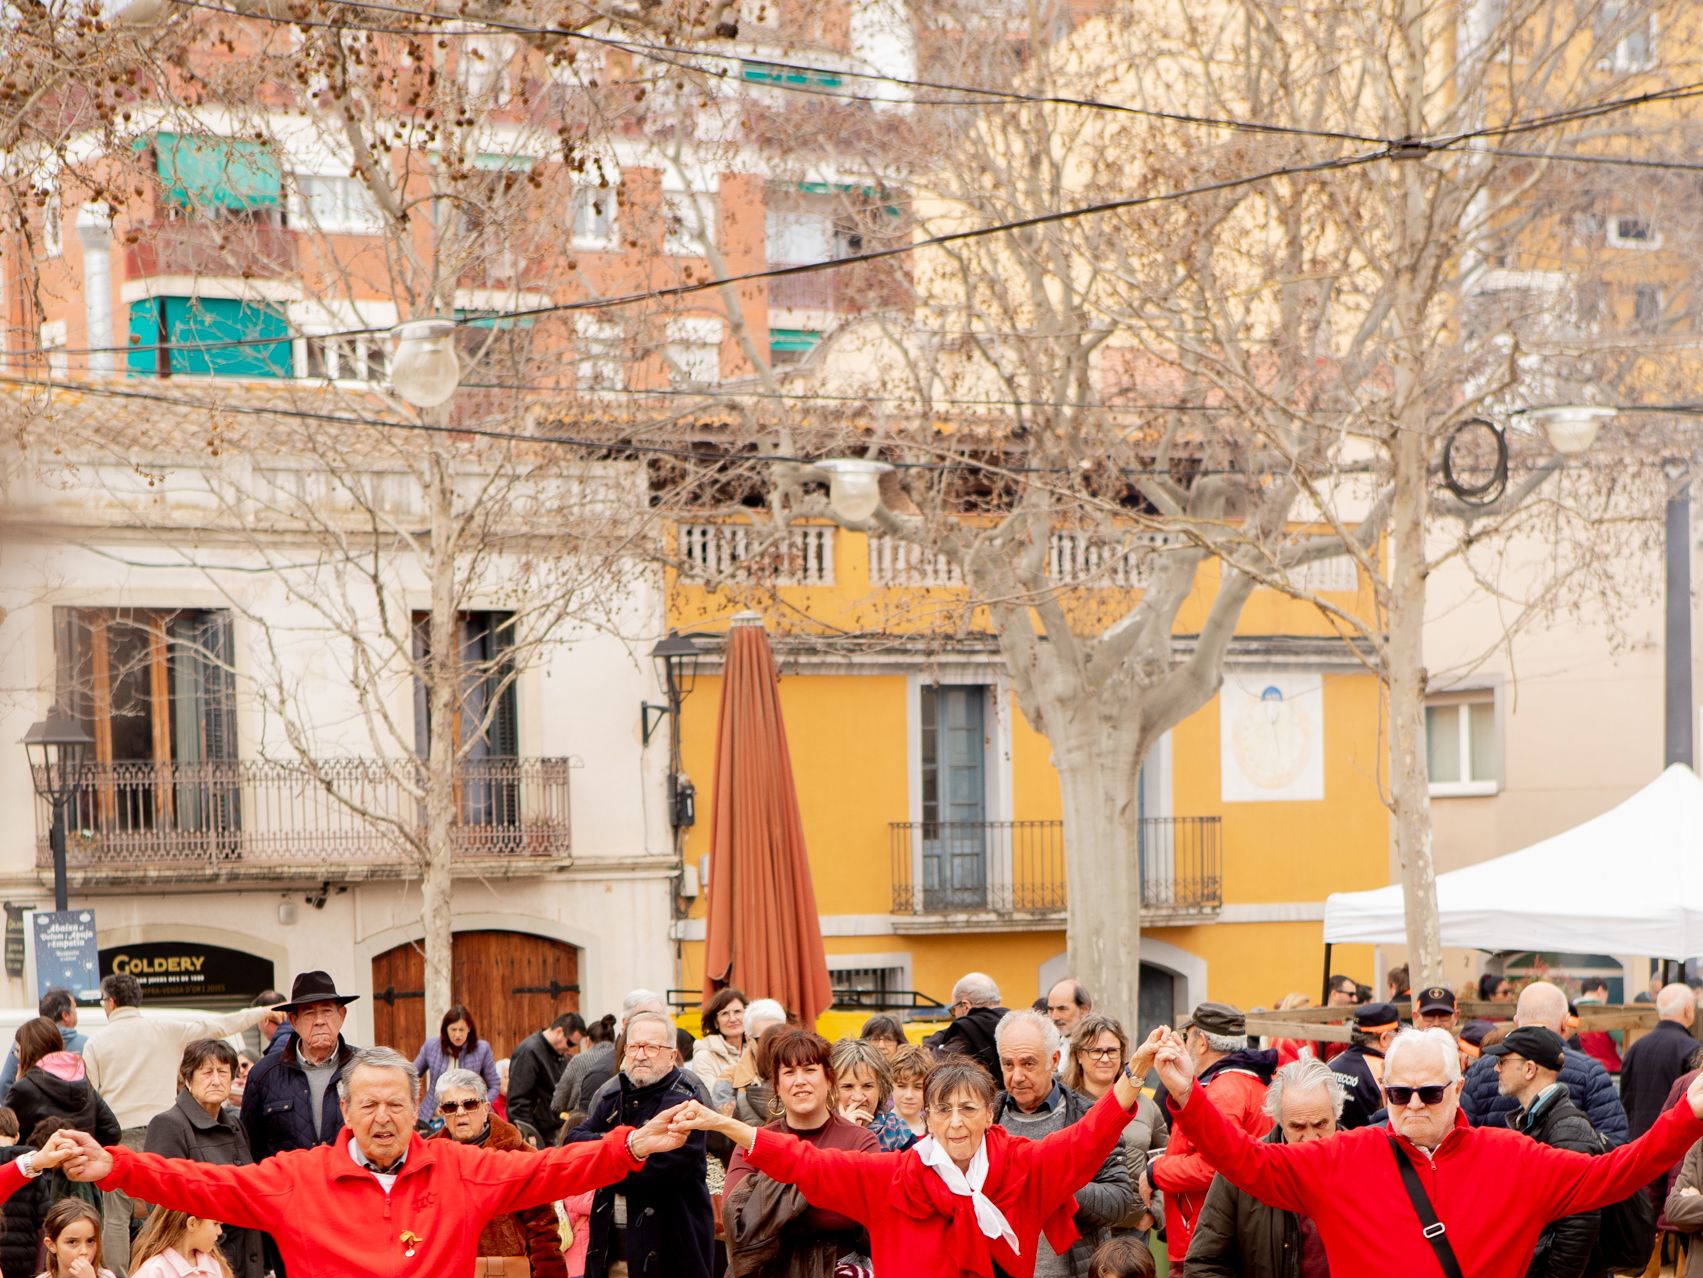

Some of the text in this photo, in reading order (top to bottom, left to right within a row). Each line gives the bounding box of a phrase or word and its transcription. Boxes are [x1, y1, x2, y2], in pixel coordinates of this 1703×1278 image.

[47, 923, 78, 934] Abaixa
[112, 954, 205, 976] GOLDERY
[1335, 1073, 1359, 1087] TECCIÓ
